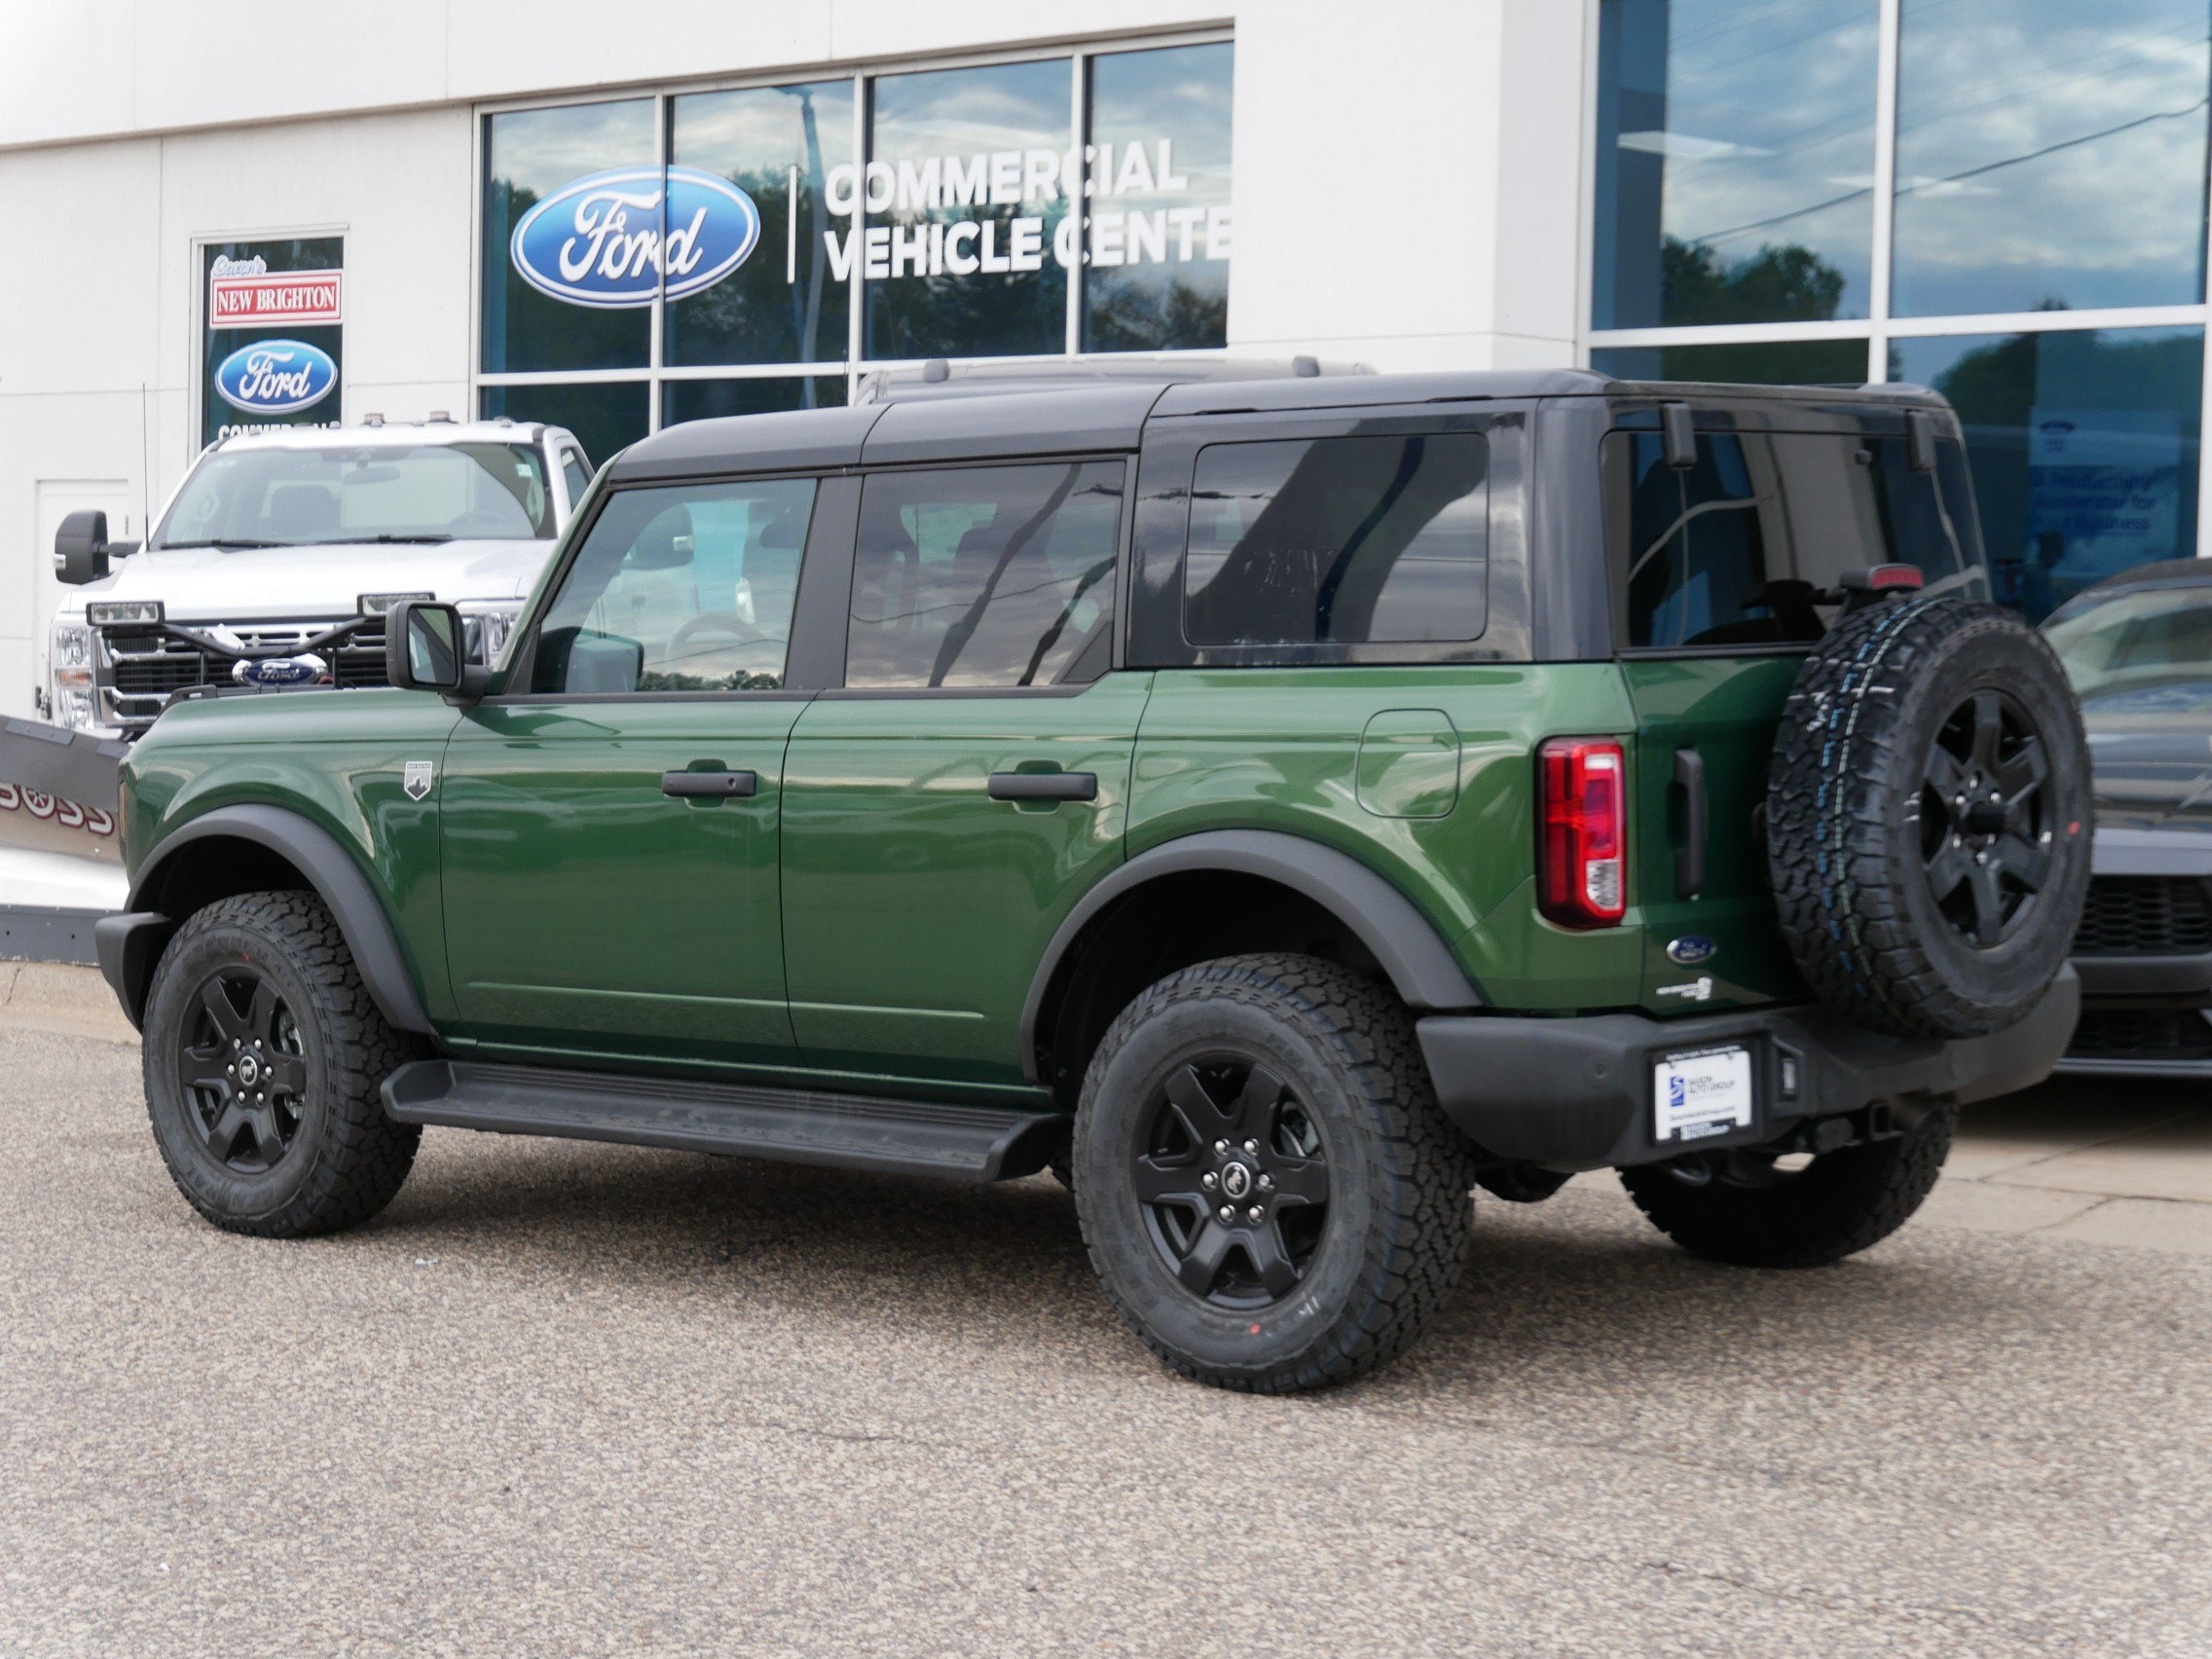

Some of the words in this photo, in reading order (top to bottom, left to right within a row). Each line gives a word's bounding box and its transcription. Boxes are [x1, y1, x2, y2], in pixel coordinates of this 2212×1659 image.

[824, 137, 1189, 216] COMMERCIAL
[559, 190, 708, 282] Ford
[824, 216, 1043, 282] VEHICLE
[1052, 204, 1234, 269] CENTE
[217, 289, 253, 313] NEW
[256, 285, 336, 312] BRIGHTON
[239, 350, 313, 400] Ford
[257, 661, 301, 681] Ford
